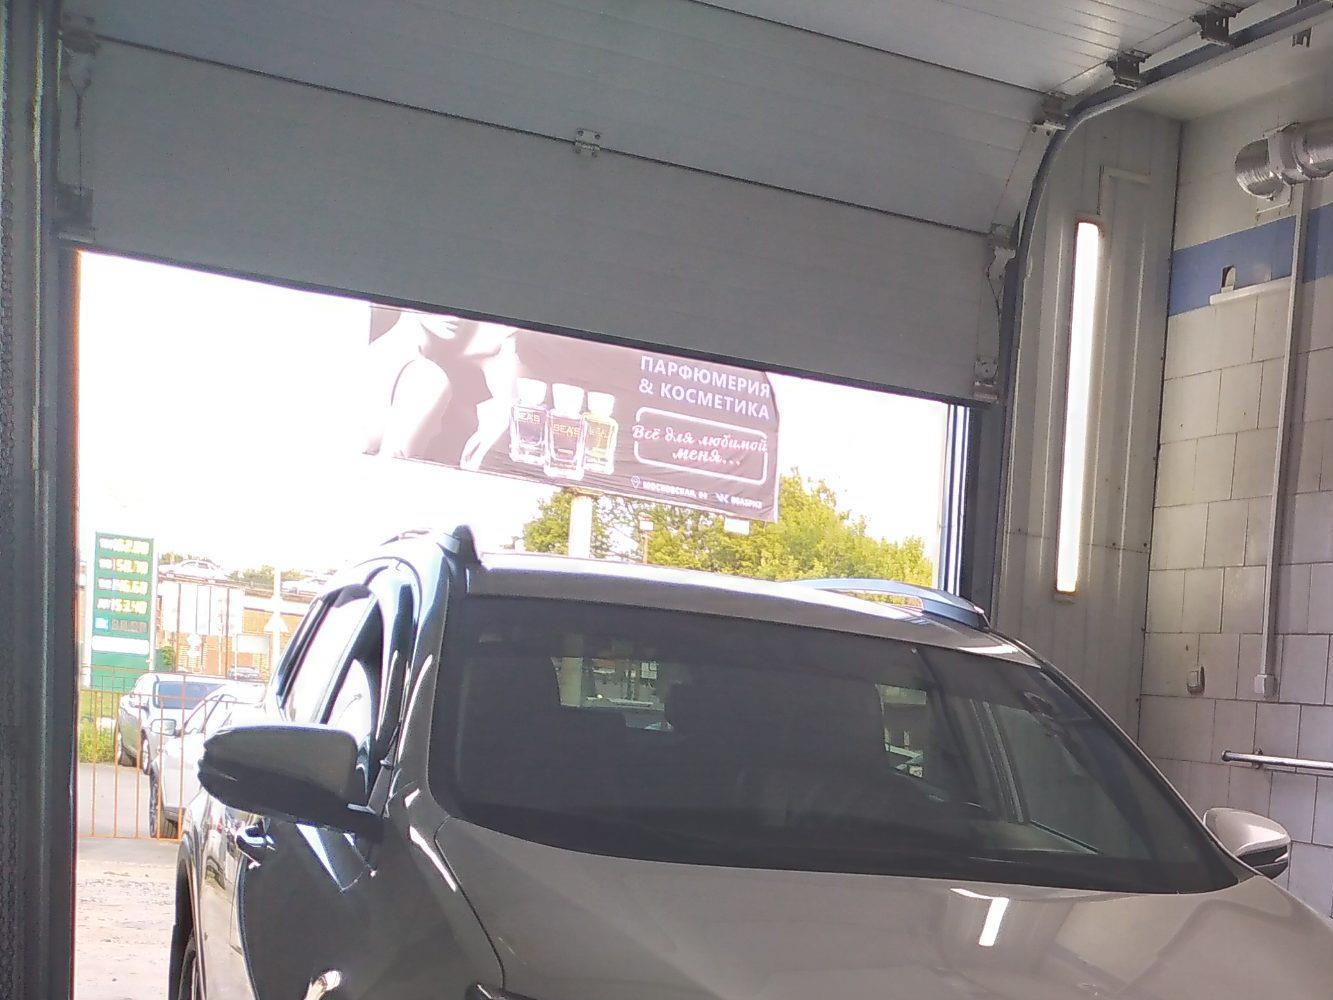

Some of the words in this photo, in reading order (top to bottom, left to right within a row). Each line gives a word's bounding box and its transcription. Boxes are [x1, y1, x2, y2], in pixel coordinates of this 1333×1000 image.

[640, 355, 771, 398] ПАРФЮМЕРИЯ
[638, 378, 654, 396] &
[660, 382, 770, 420] КОСМЕТИКА
[631, 424, 661, 441] Всё
[664, 426, 695, 444] для
[697, 434, 769, 453] любимой
